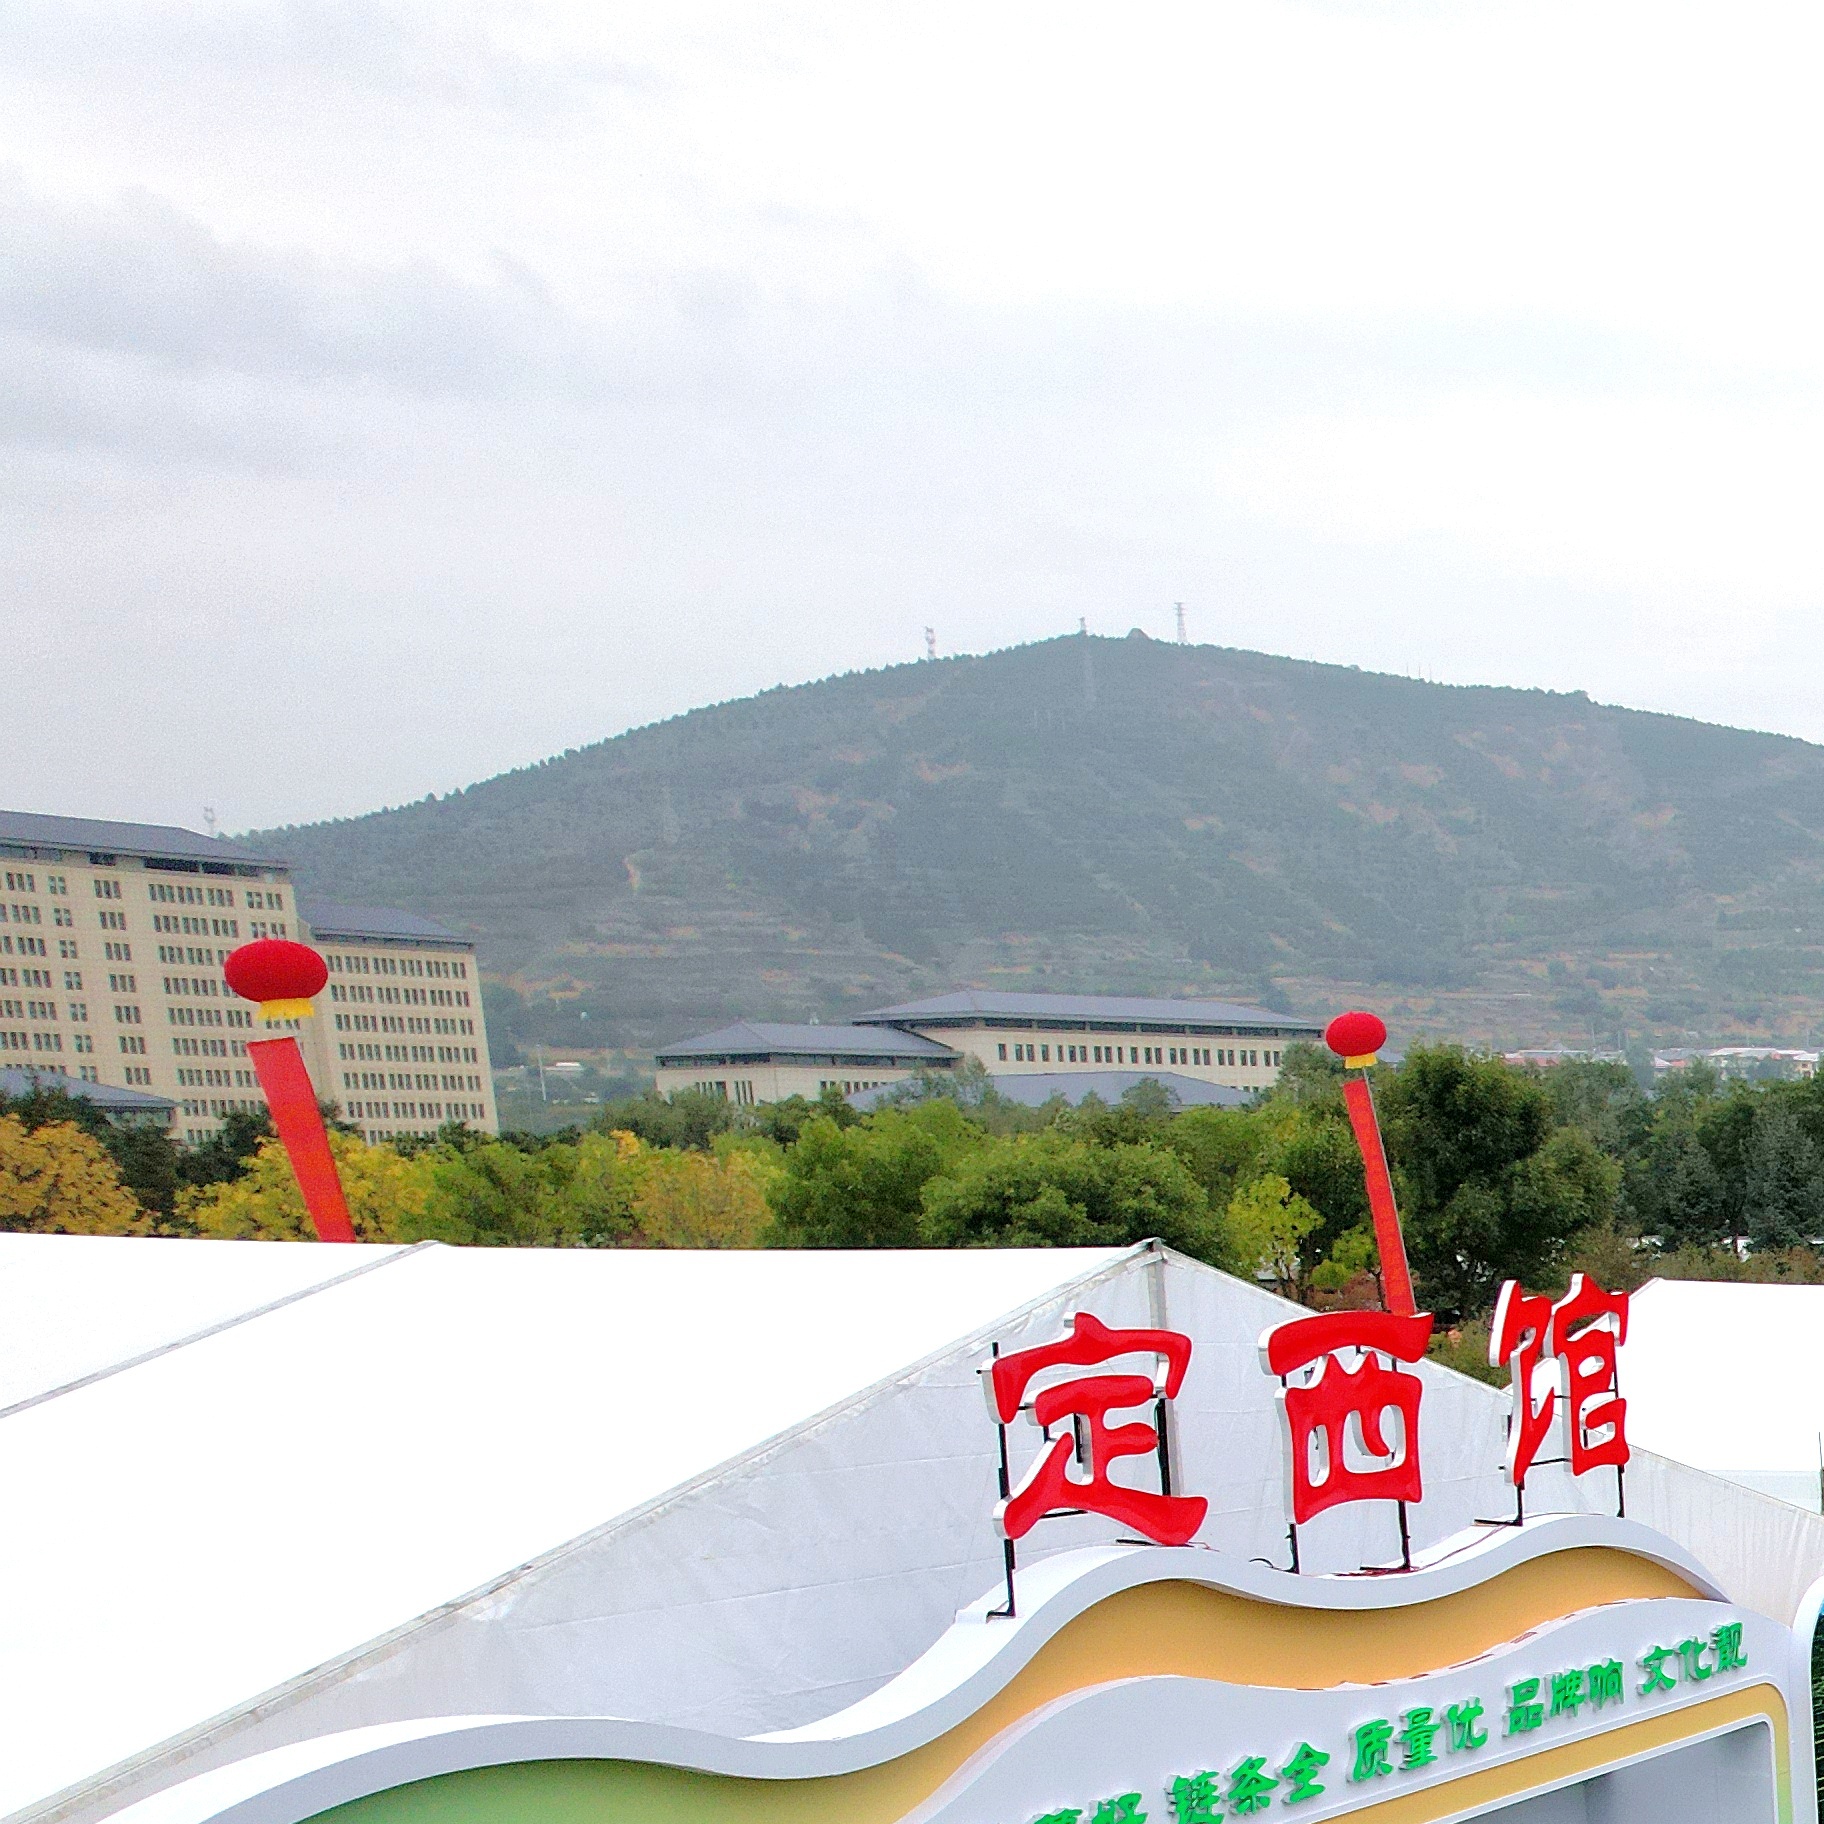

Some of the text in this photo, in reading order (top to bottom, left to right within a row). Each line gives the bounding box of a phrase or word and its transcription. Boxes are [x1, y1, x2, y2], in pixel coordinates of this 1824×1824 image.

[981, 1272, 1630, 1547] 定西馆
[1348, 1696, 1489, 1784] 质量优
[1504, 1657, 1625, 1733] 品牌响
[1637, 1621, 1749, 1697] 文化靓
